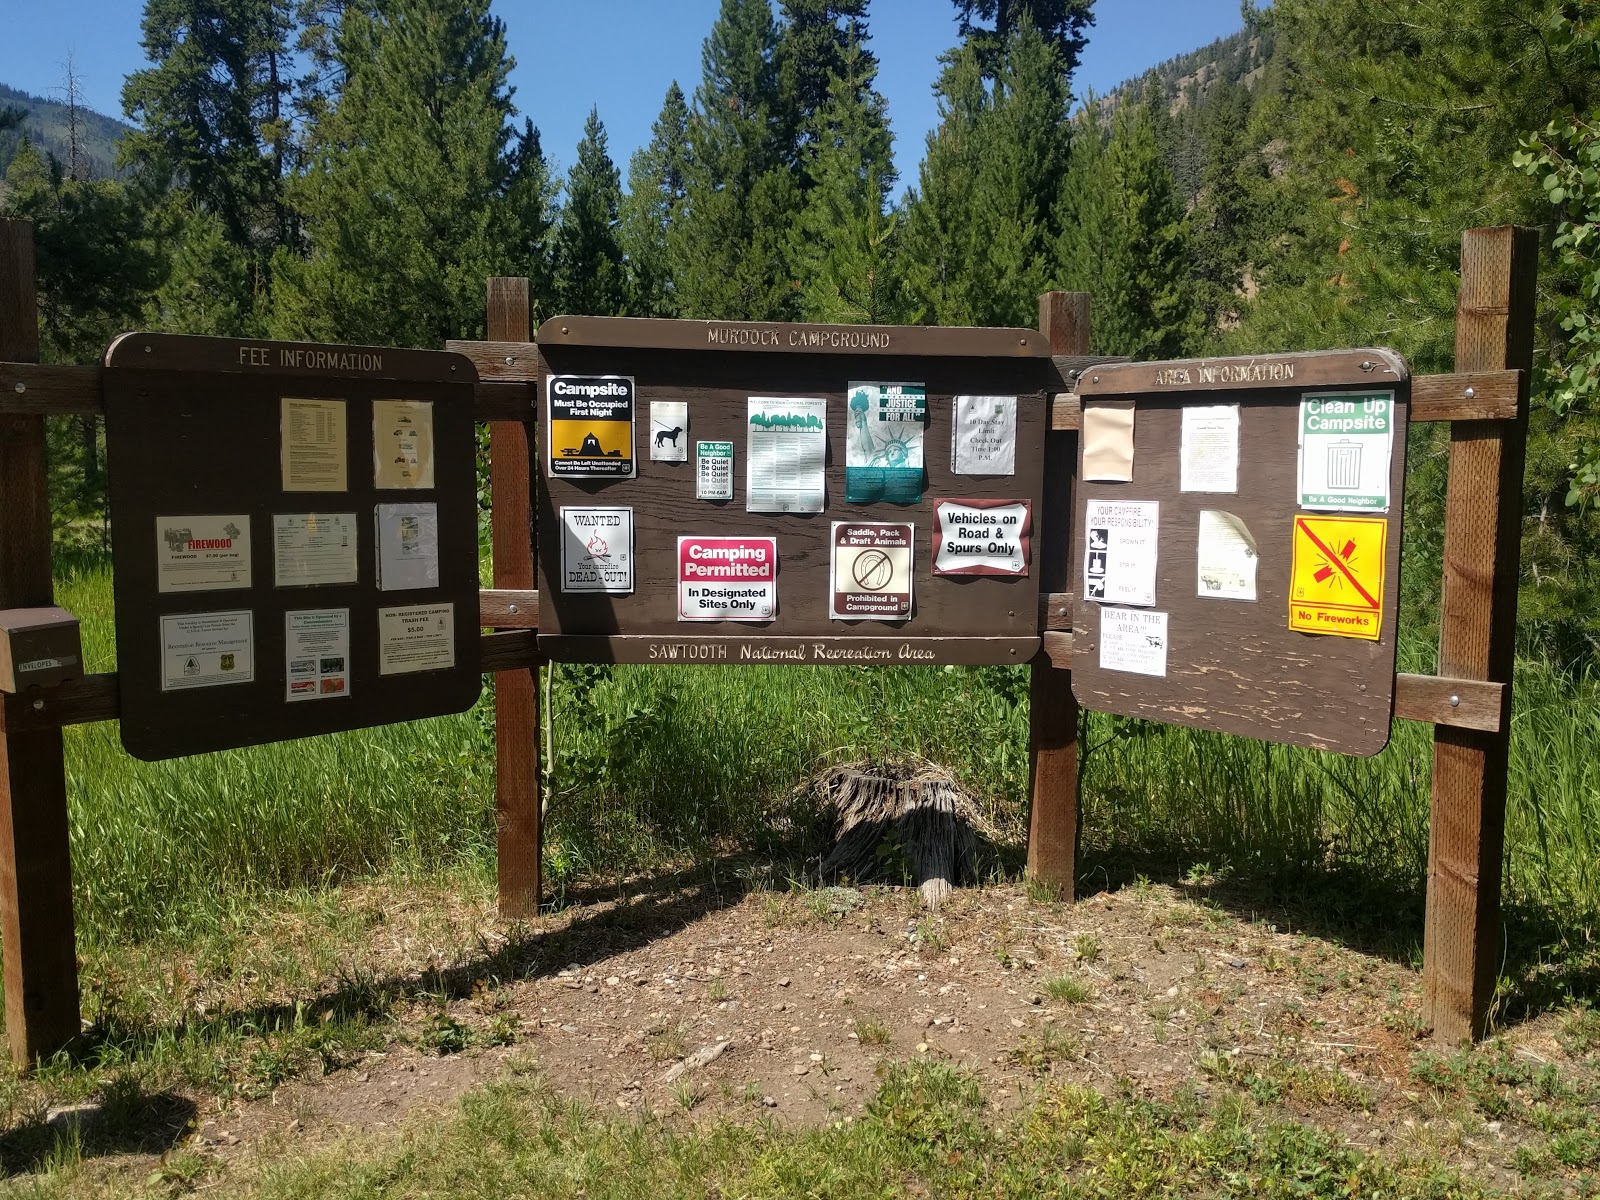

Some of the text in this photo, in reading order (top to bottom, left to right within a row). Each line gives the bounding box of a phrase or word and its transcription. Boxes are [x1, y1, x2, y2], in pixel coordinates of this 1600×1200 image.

[708, 328, 890, 348] MURDOCK CAMPGROUND
[239, 347, 384, 372] FEE INFORMATION
[1155, 367, 1191, 385] AREA
[554, 381, 628, 398] Campsite
[553, 399, 629, 410] Must Be Occupied
[885, 399, 917, 408] JUSTICE
[1307, 397, 1387, 416] Clean Up
[570, 408, 613, 418] First Night
[885, 412, 901, 422] FOR
[978, 419, 990, 427] Day
[991, 418, 1005, 427] Stay
[1306, 414, 1386, 433] Campsite
[1308, 495, 1318, 503] Be
[1327, 496, 1346, 504] Good
[1347, 496, 1378, 505] Neighbor
[1096, 506, 1113, 516] YOUR
[573, 515, 621, 527] WANTED
[947, 512, 1017, 524] Vehicles on
[1090, 516, 1106, 526] YOUR
[846, 528, 900, 538] Saddle, Pack
[958, 527, 1004, 539] Road &
[188, 538, 232, 550] FIREWOOD
[840, 537, 907, 546] & Draft Animals
[688, 544, 766, 562] Camping
[947, 541, 1015, 556] Spurs Only
[577, 562, 620, 572] Your campfire
[685, 562, 770, 577] Permitted
[688, 588, 766, 600] In Designated
[1118, 585, 1131, 593] FEEL
[699, 599, 756, 611] Sites Only
[846, 595, 898, 603] Prohibited in
[428, 608, 450, 616] CAMPING
[846, 603, 898, 613] Campground
[1104, 610, 1161, 625] BEAR IN THE
[1298, 610, 1370, 626] No Fireworks
[407, 625, 424, 633] $5.00
[1102, 632, 1123, 641] PLEASE
[167, 641, 195, 650] Recreation
[195, 640, 218, 648] Resource
[218, 638, 248, 647] Management
[649, 643, 936, 661] SAWTOOTH National Recreation Area
[19, 660, 52, 670] ENVELOPES
